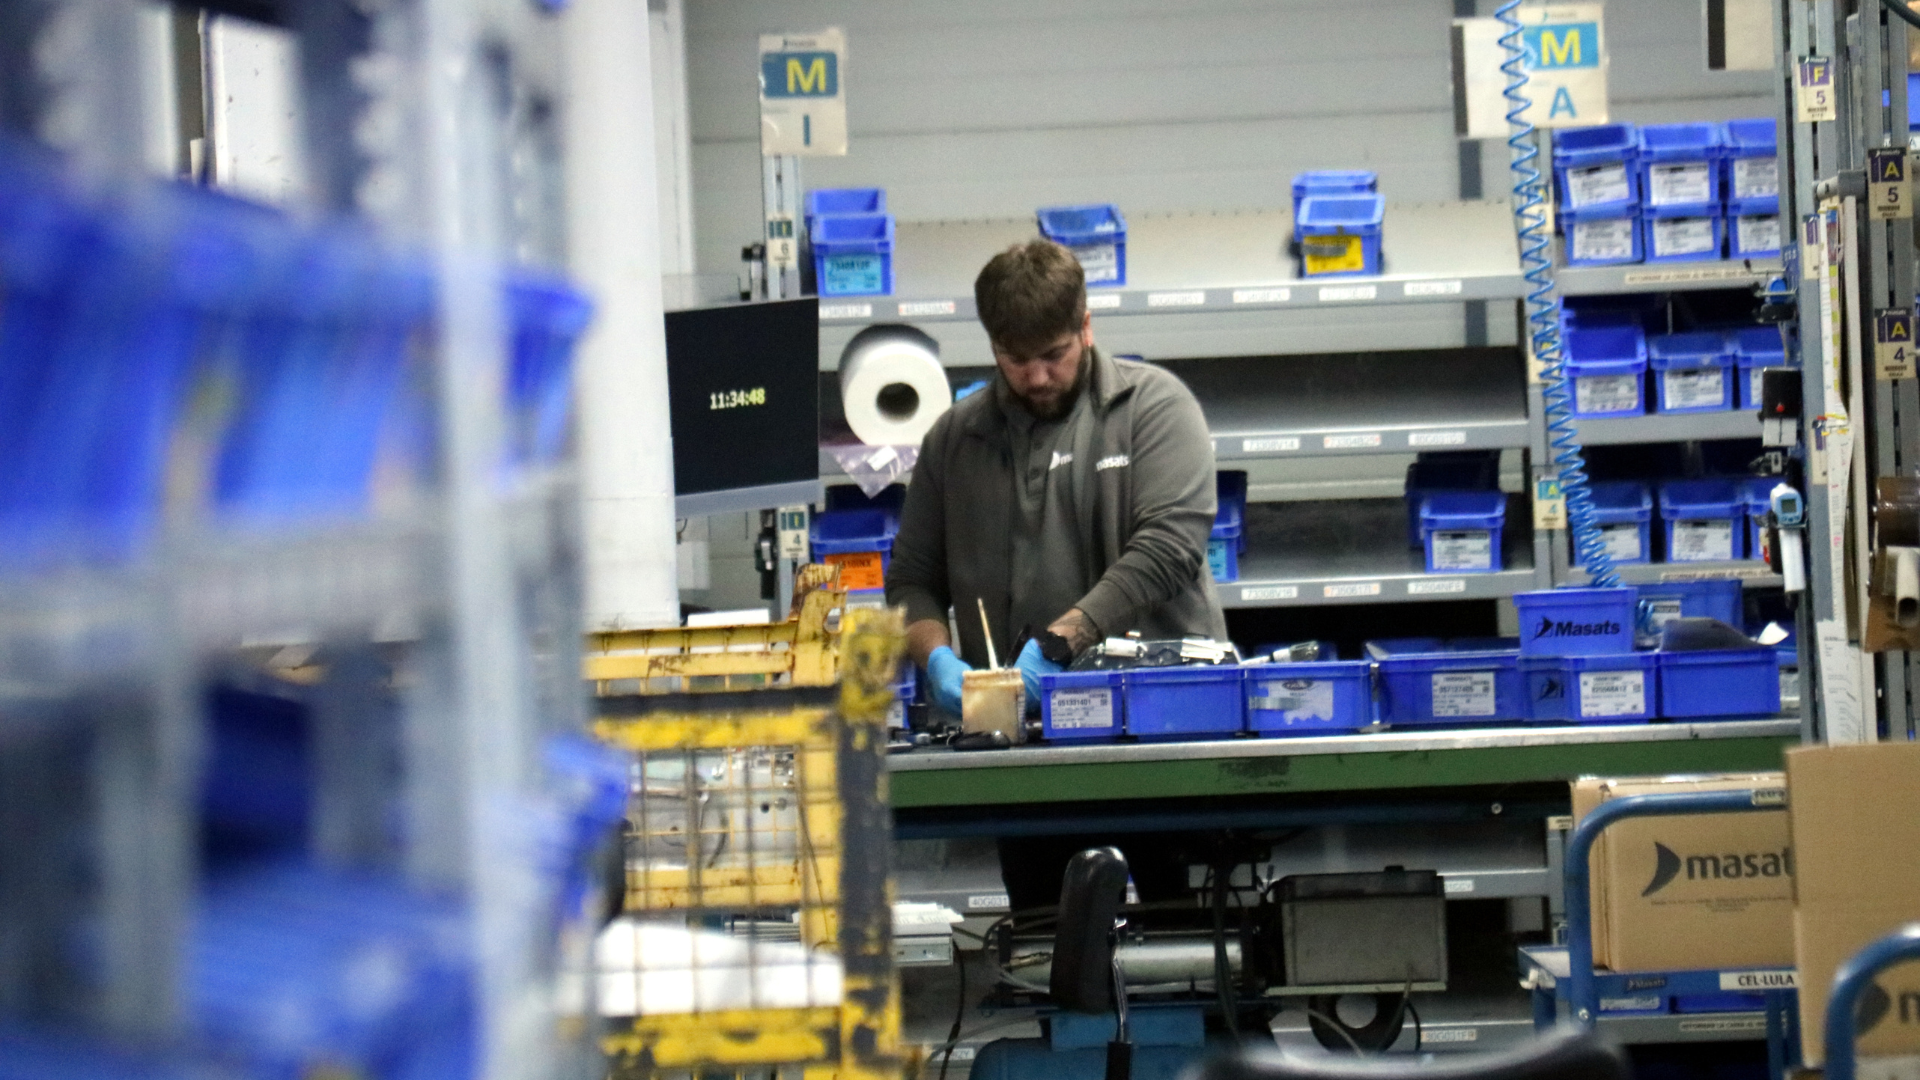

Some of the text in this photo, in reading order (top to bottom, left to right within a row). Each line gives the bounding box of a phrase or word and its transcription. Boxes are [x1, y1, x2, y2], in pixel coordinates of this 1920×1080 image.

[1540, 28, 1582, 66] M
[786, 57, 827, 93] M
[1813, 67, 1825, 83] F
[1549, 86, 1578, 119] A
[1815, 90, 1826, 104] 5
[1884, 161, 1900, 178] A
[1886, 187, 1899, 203] 5
[1890, 321, 1907, 338] A
[1893, 346, 1906, 363] 4
[709, 387, 766, 410] 11:34:48
[1554, 619, 1621, 637] Masats
